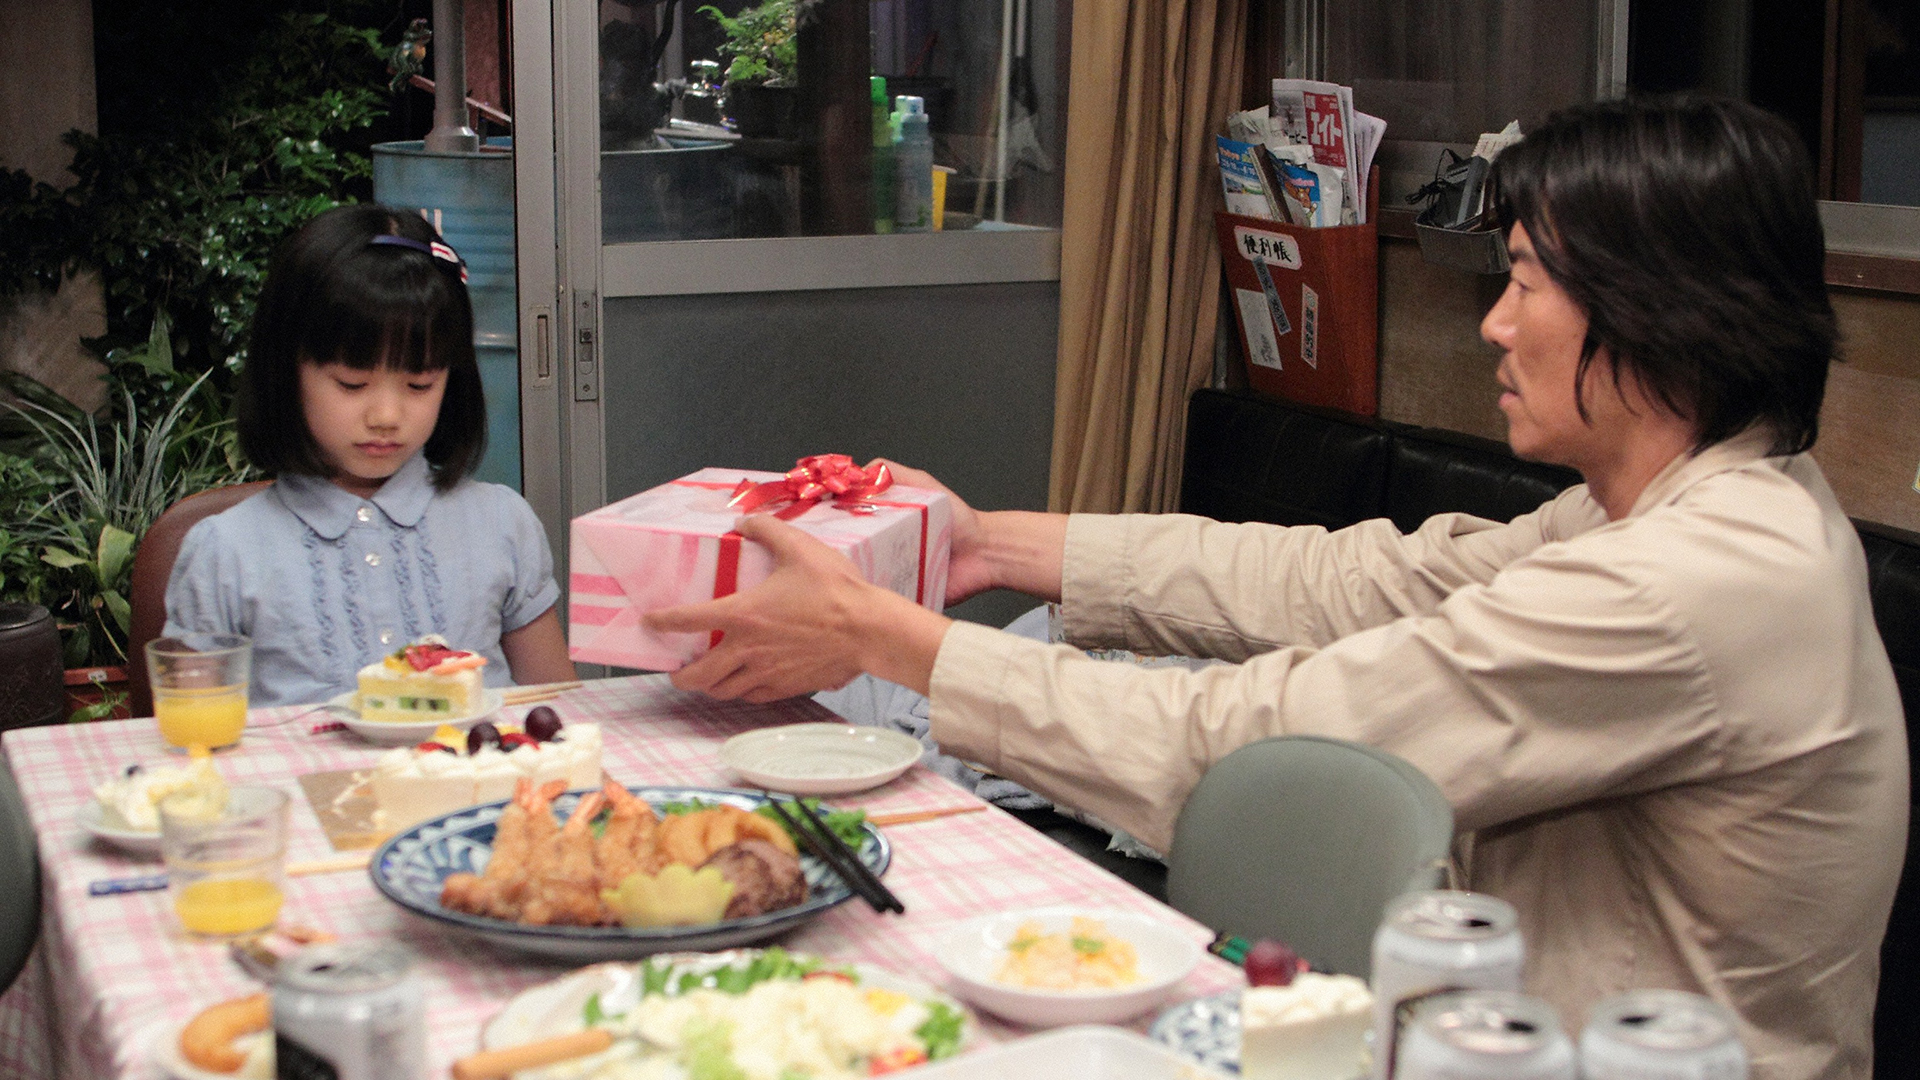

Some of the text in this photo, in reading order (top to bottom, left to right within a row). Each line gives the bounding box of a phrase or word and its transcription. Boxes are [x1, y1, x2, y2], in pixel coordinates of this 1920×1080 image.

[1311, 111, 1342, 147] エイト
[1243, 234, 1293, 263] 便利帳
